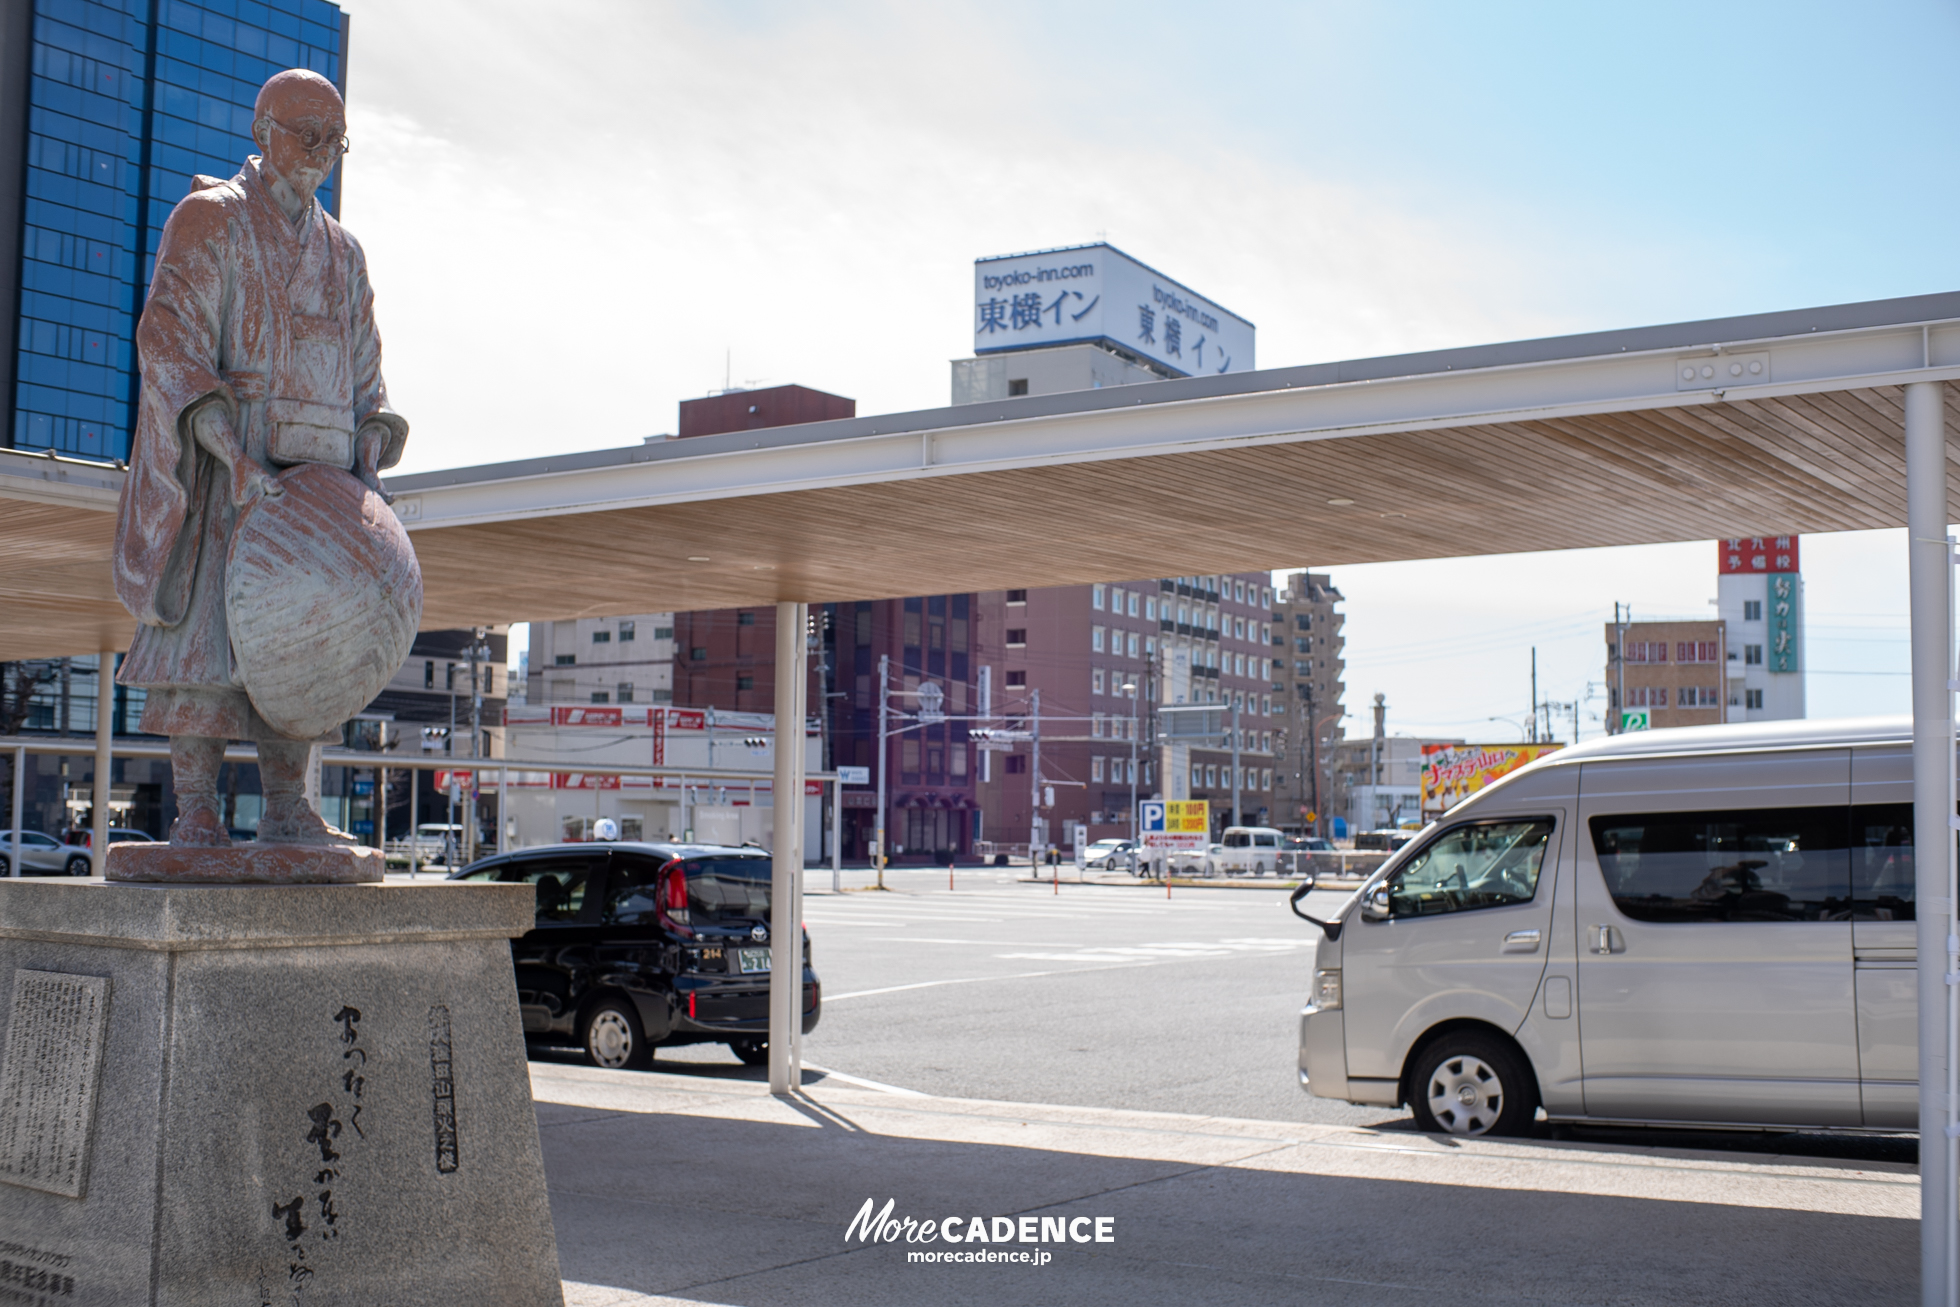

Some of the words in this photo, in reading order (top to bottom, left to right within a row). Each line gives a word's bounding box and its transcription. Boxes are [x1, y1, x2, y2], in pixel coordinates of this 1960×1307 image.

[983, 262, 1094, 291] toyoko-inn.com
[977, 289, 1100, 334] 東横イン
[1152, 283, 1219, 333] toyoko-inn.com
[1137, 303, 1232, 374] 東横イン
[1728, 538, 1791, 550] 北九州
[1727, 555, 1791, 569] 予備校
[1144, 804, 1163, 830] P
[703, 949, 722, 959] 214
